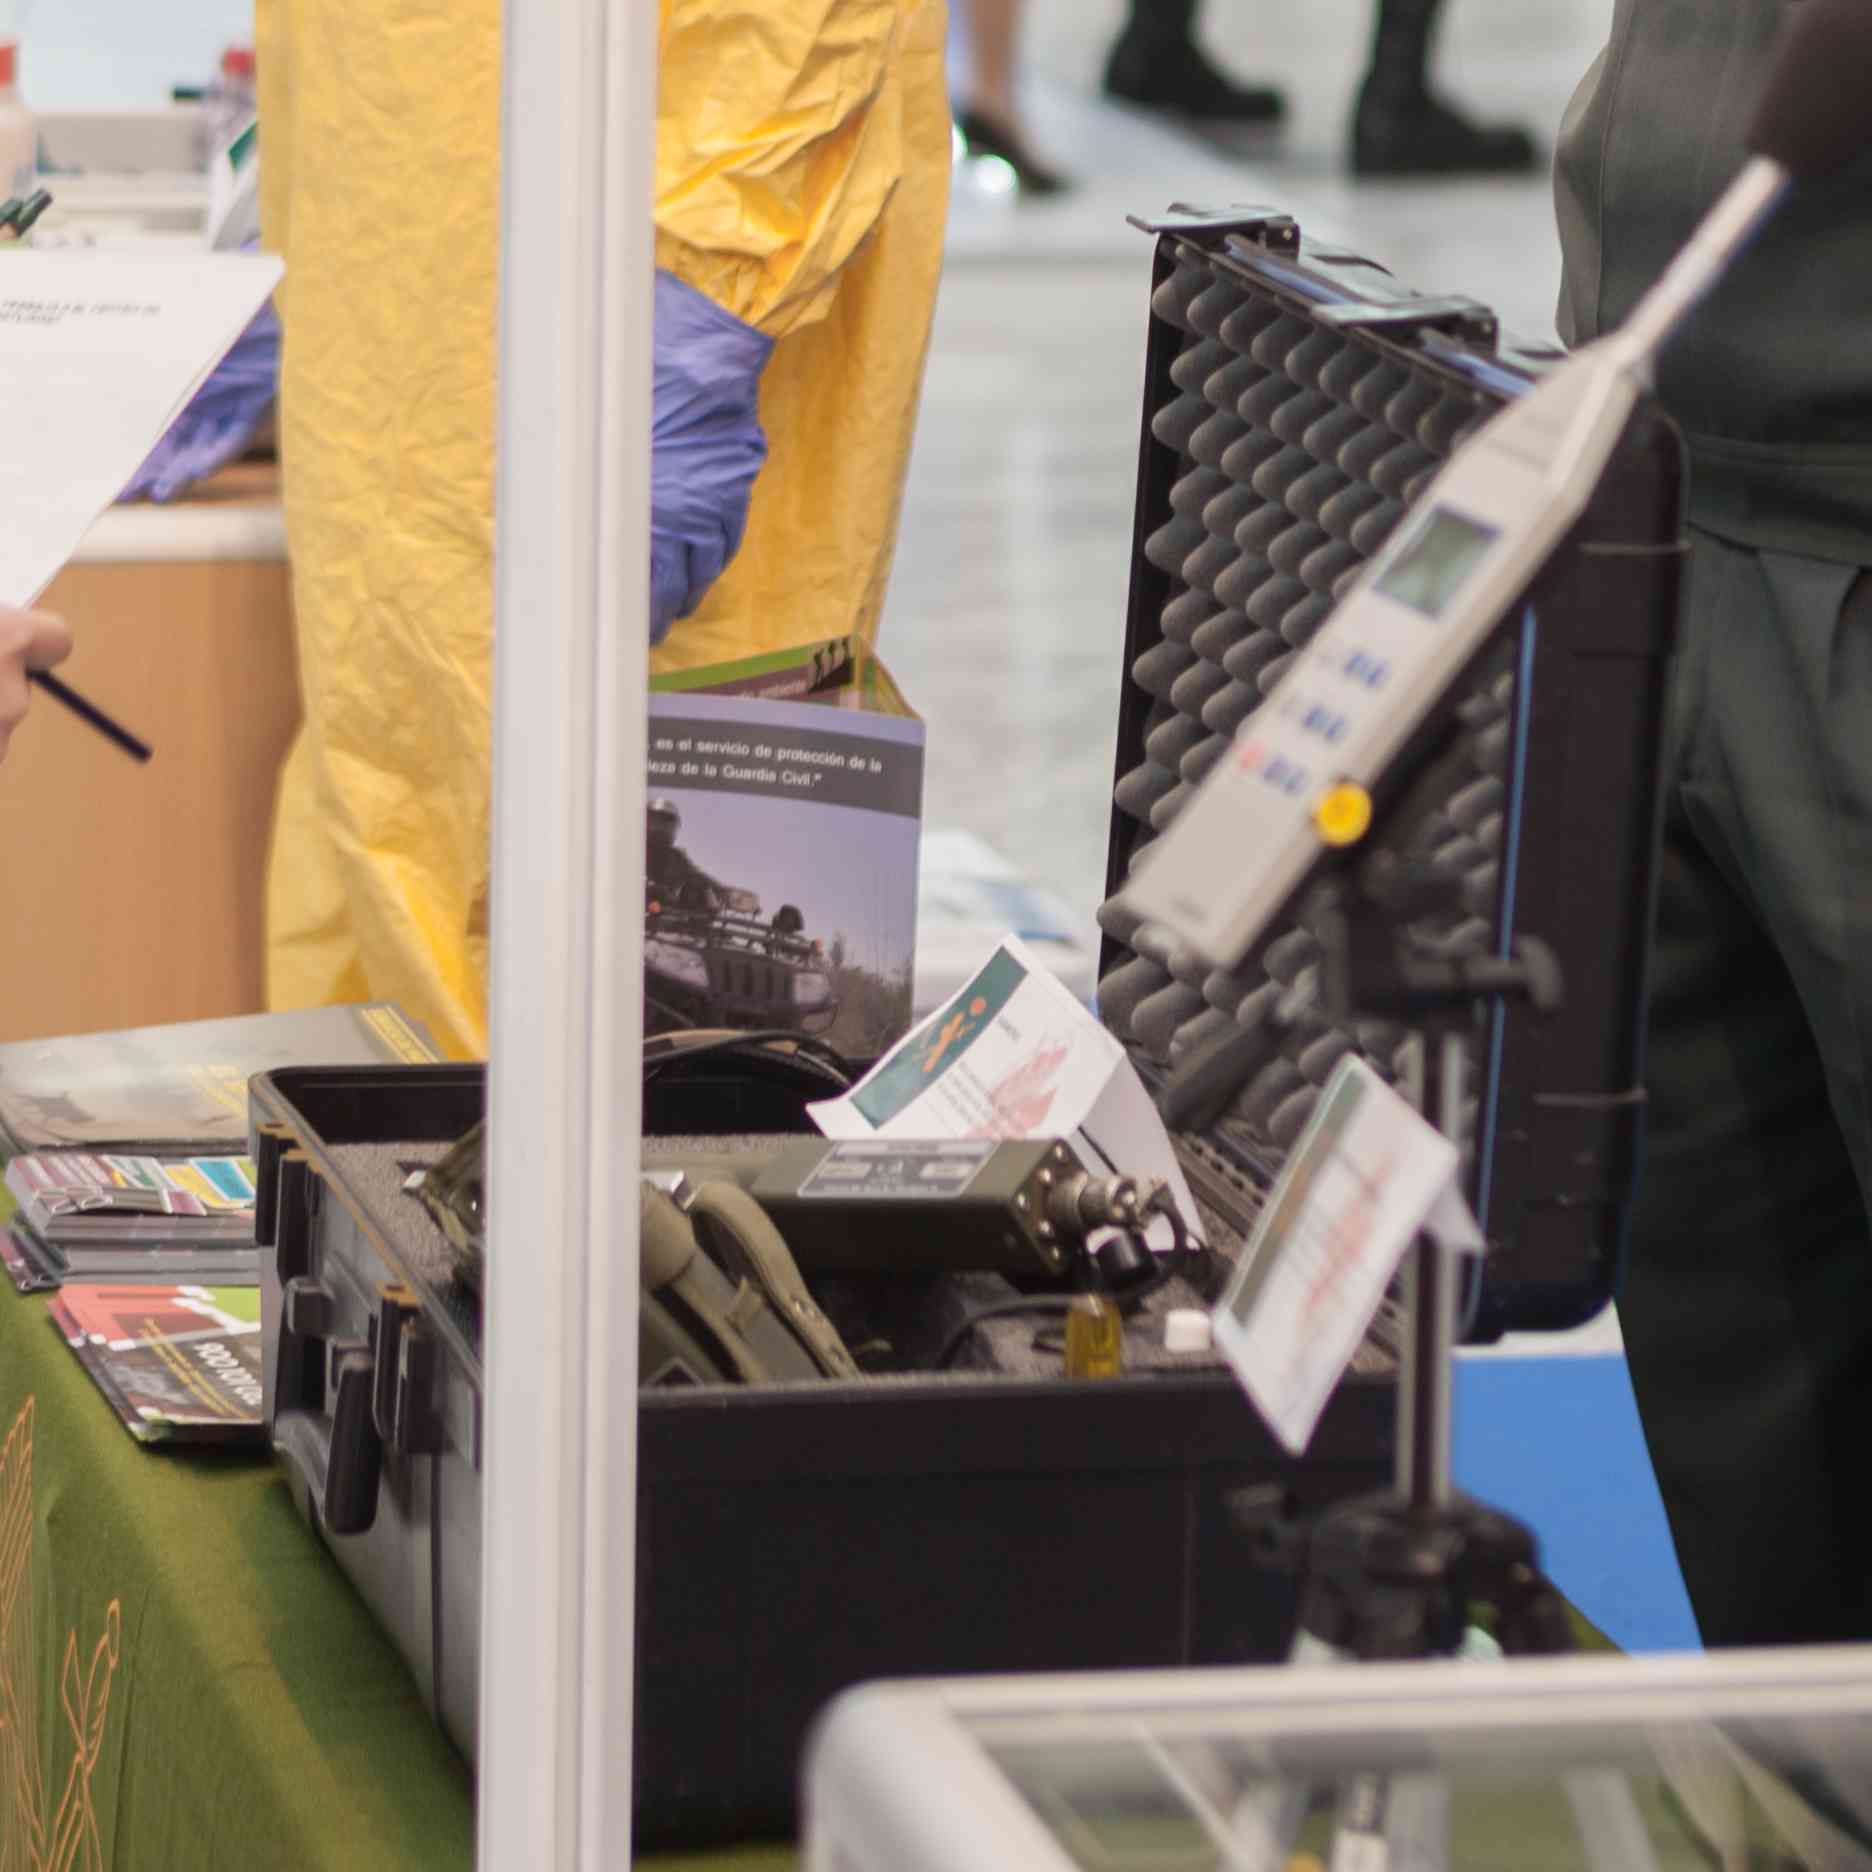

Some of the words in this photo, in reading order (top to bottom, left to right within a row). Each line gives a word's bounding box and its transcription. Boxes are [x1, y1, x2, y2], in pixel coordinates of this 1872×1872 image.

[696, 737, 750, 756] servicio
[754, 743, 772, 758] de
[777, 744, 845, 768] protección
[848, 752, 866, 770] de
[869, 757, 883, 773] la
[681, 761, 699, 776] de
[705, 762, 718, 777] la
[722, 763, 777, 783] Guardia
